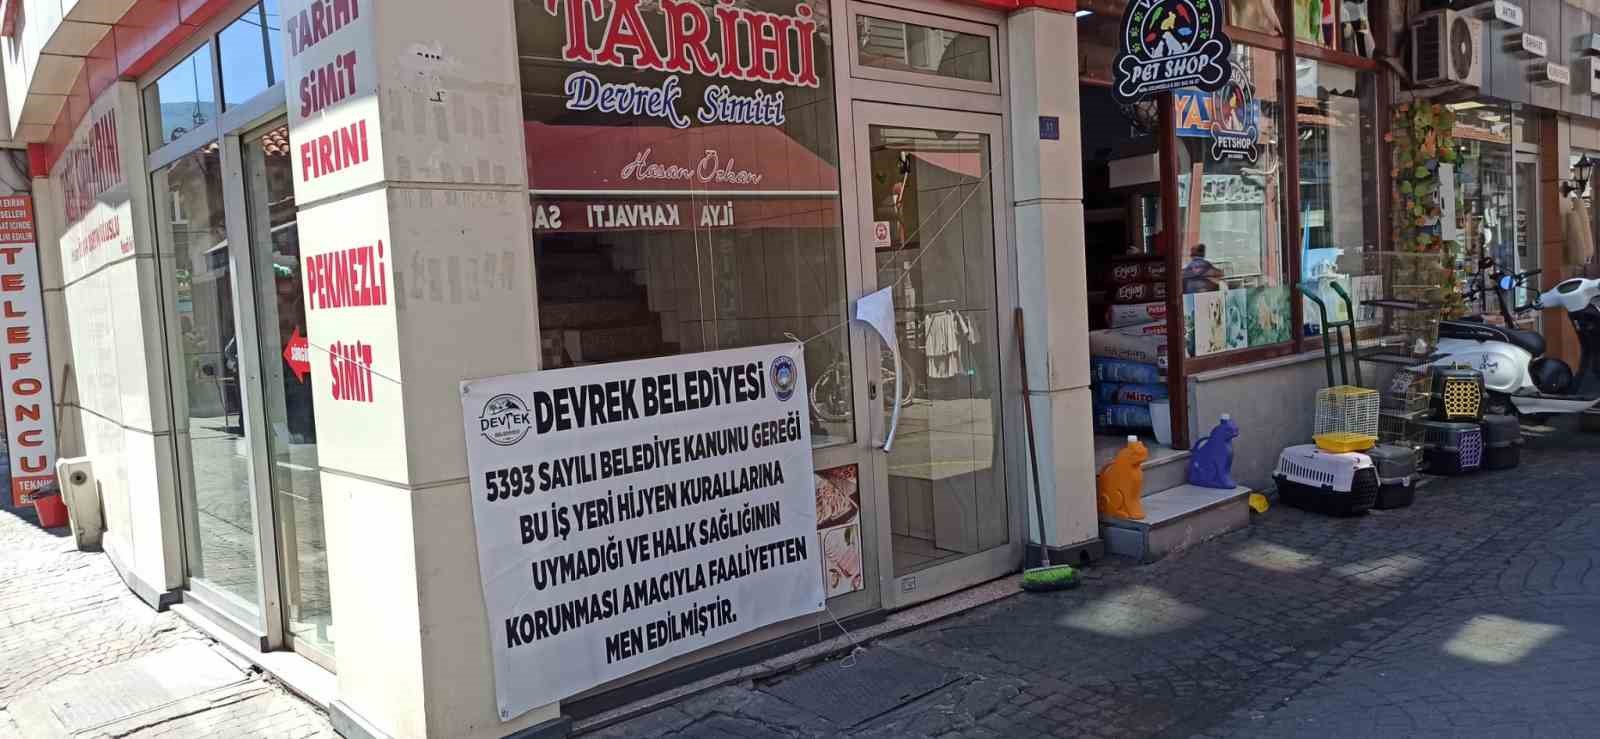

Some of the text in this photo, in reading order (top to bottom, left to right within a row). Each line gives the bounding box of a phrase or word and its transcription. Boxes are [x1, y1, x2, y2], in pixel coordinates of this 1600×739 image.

[545, 0, 819, 87] TARİHİ
[1132, 54, 1209, 83] PET SHOP
[300, 50, 357, 118] SİMİT
[566, 72, 785, 128] Devrek Simiti
[300, 119, 369, 182] FIRINI
[621, 149, 763, 185] Hasan Özkan
[1218, 136, 1251, 149] PETSHOP
[306, 239, 387, 310] PEKMEZLİ
[0, 247, 47, 474] TELEFONCU
[330, 340, 374, 403] SİMİT
[533, 361, 766, 435] DEVREK BELEDİYESİ
[485, 410, 802, 502] 5393 SAYILI BELEDİYE KANUNU GEREĞİ
[519, 460, 784, 544] BU İŞ YERİ HİJYEN KURALLARINA
[532, 501, 781, 591] UYMADIĞI VE HALK SAĞLIĞININ
[505, 536, 807, 648] KORUNMASI AMACIYLA FAALİYETTEN
[605, 595, 737, 664] MEN EDİLMİŞTİR.
